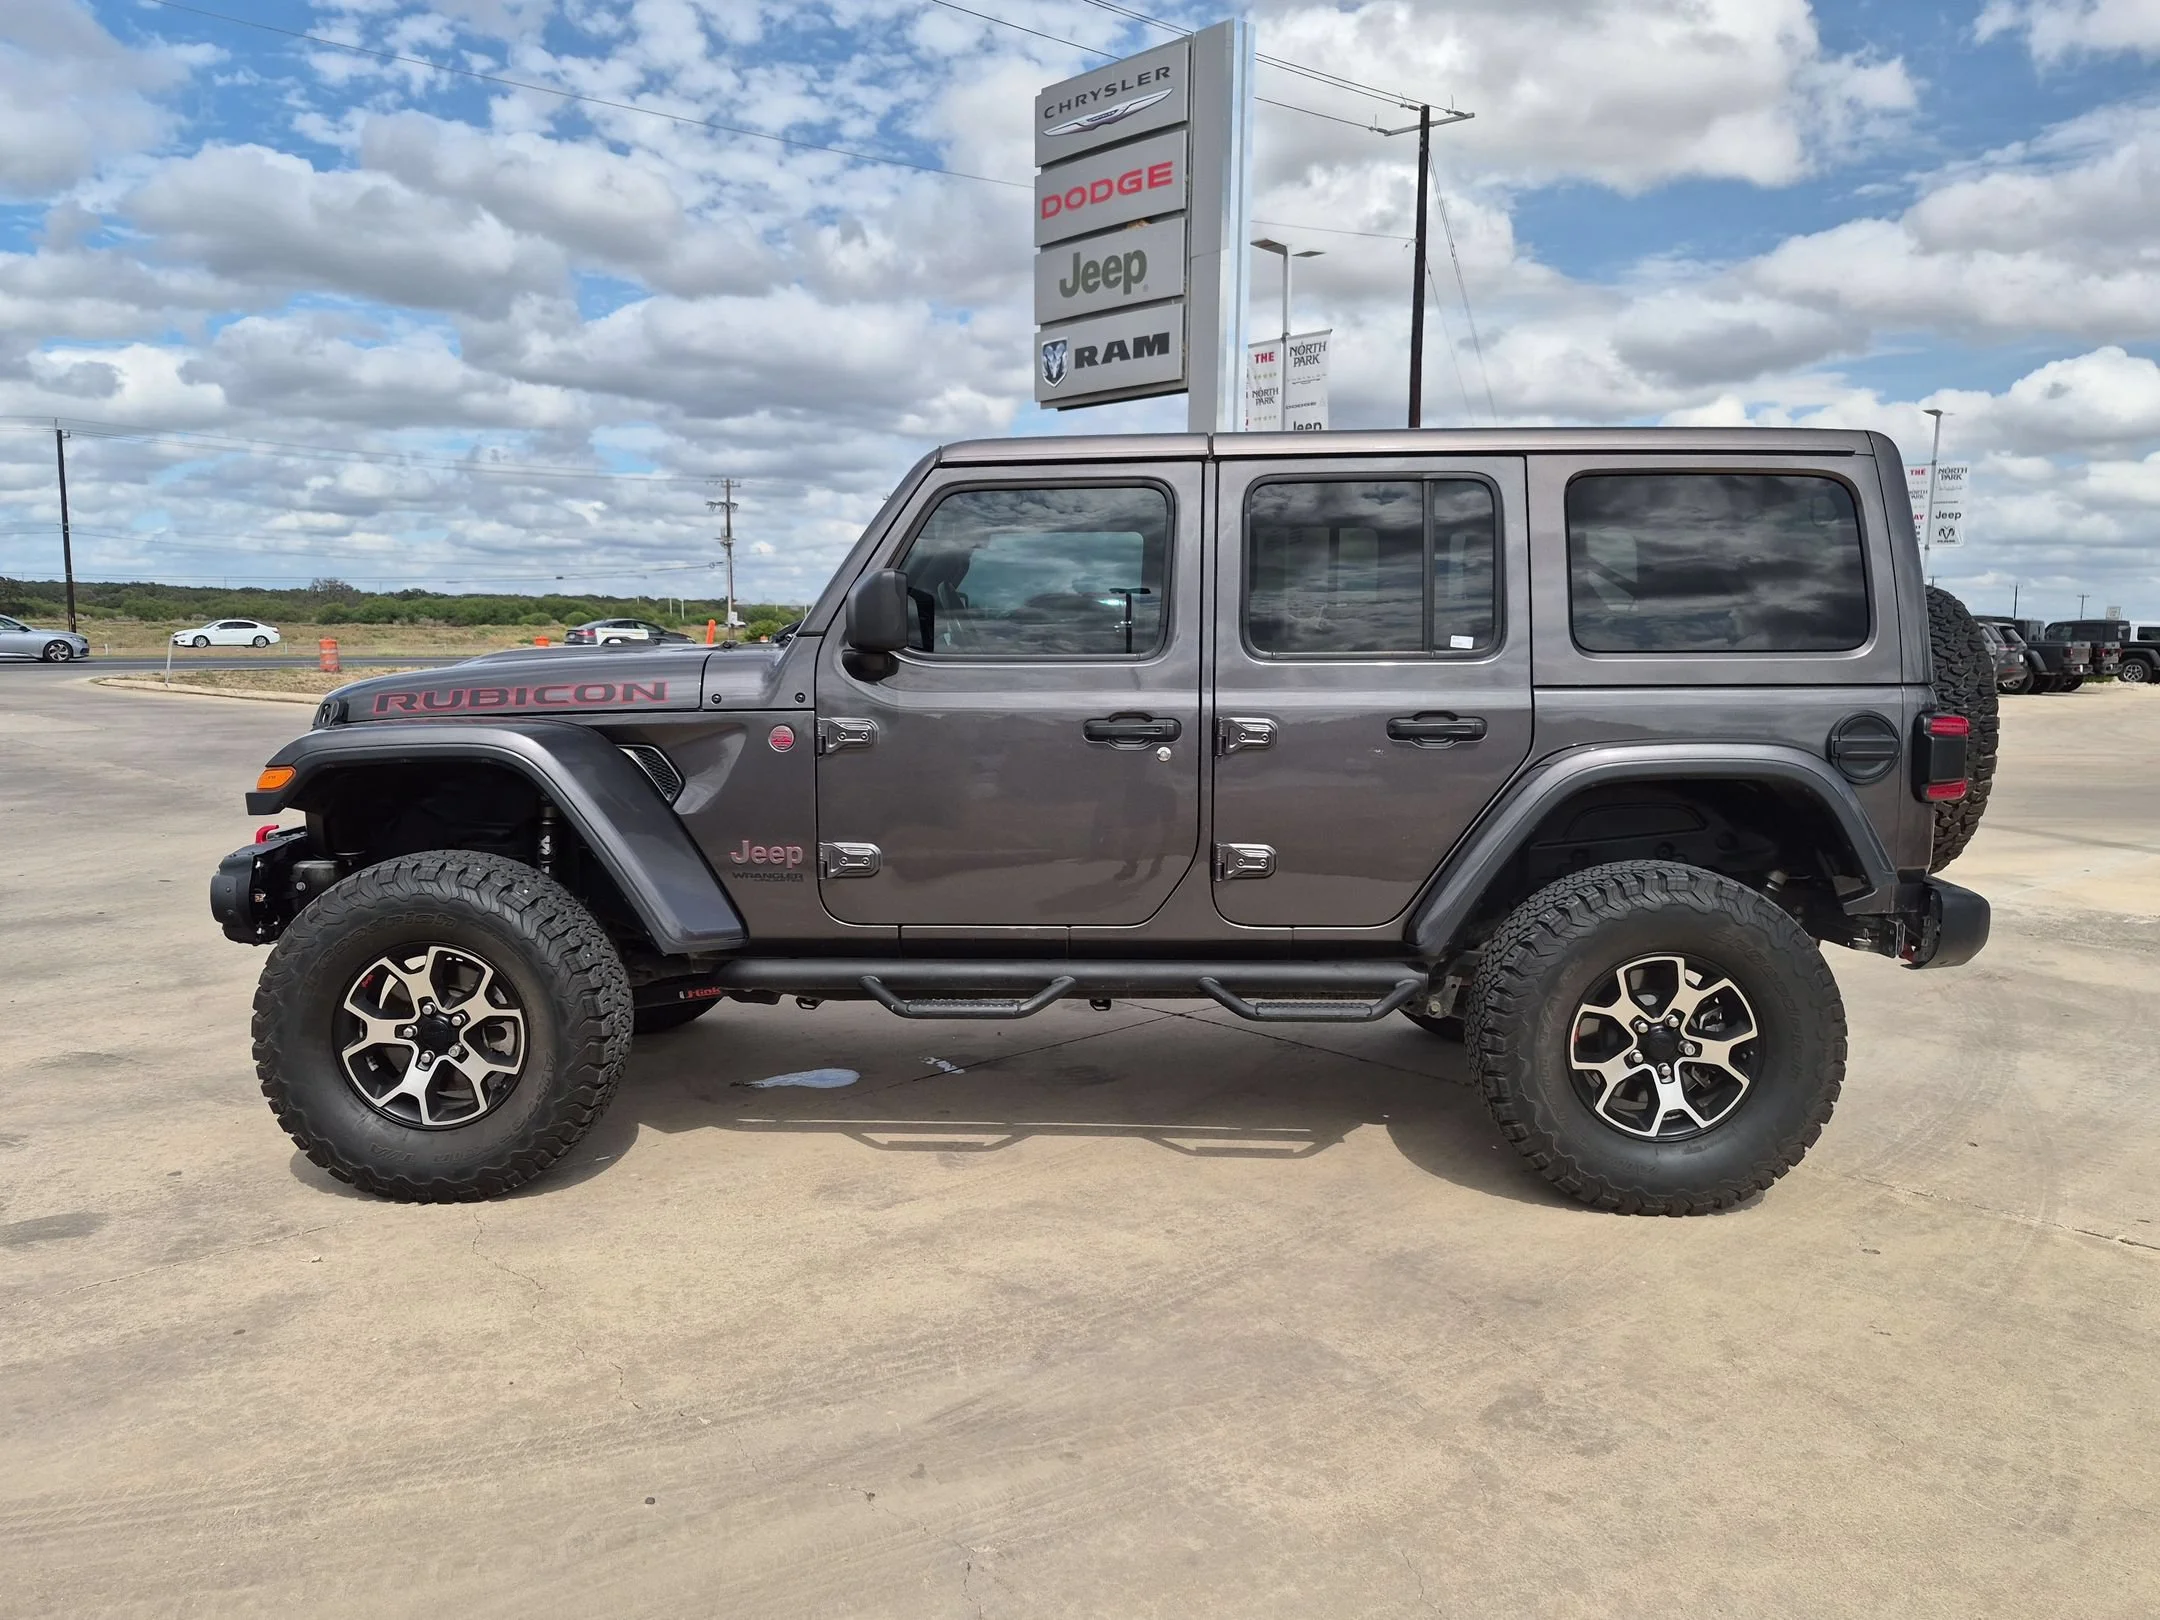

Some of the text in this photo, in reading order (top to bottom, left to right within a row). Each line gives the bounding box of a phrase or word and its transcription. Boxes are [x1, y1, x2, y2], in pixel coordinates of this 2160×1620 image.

[1043, 65, 1172, 120] CHRYSLER
[1041, 161, 1173, 220] DODGE
[1059, 249, 1148, 298] Jeep
[1074, 331, 1171, 370] RAM
[1289, 341, 1326, 357] NORTH
[1254, 351, 1275, 364] THE
[1293, 354, 1320, 367] PARK
[1252, 387, 1279, 398] NORTH
[1255, 397, 1274, 406] PARK
[1935, 510, 1961, 520] Jeep
[373, 680, 669, 714] RUBICON
[730, 839, 804, 869] Jeep
[732, 871, 804, 882] WRANGLER
